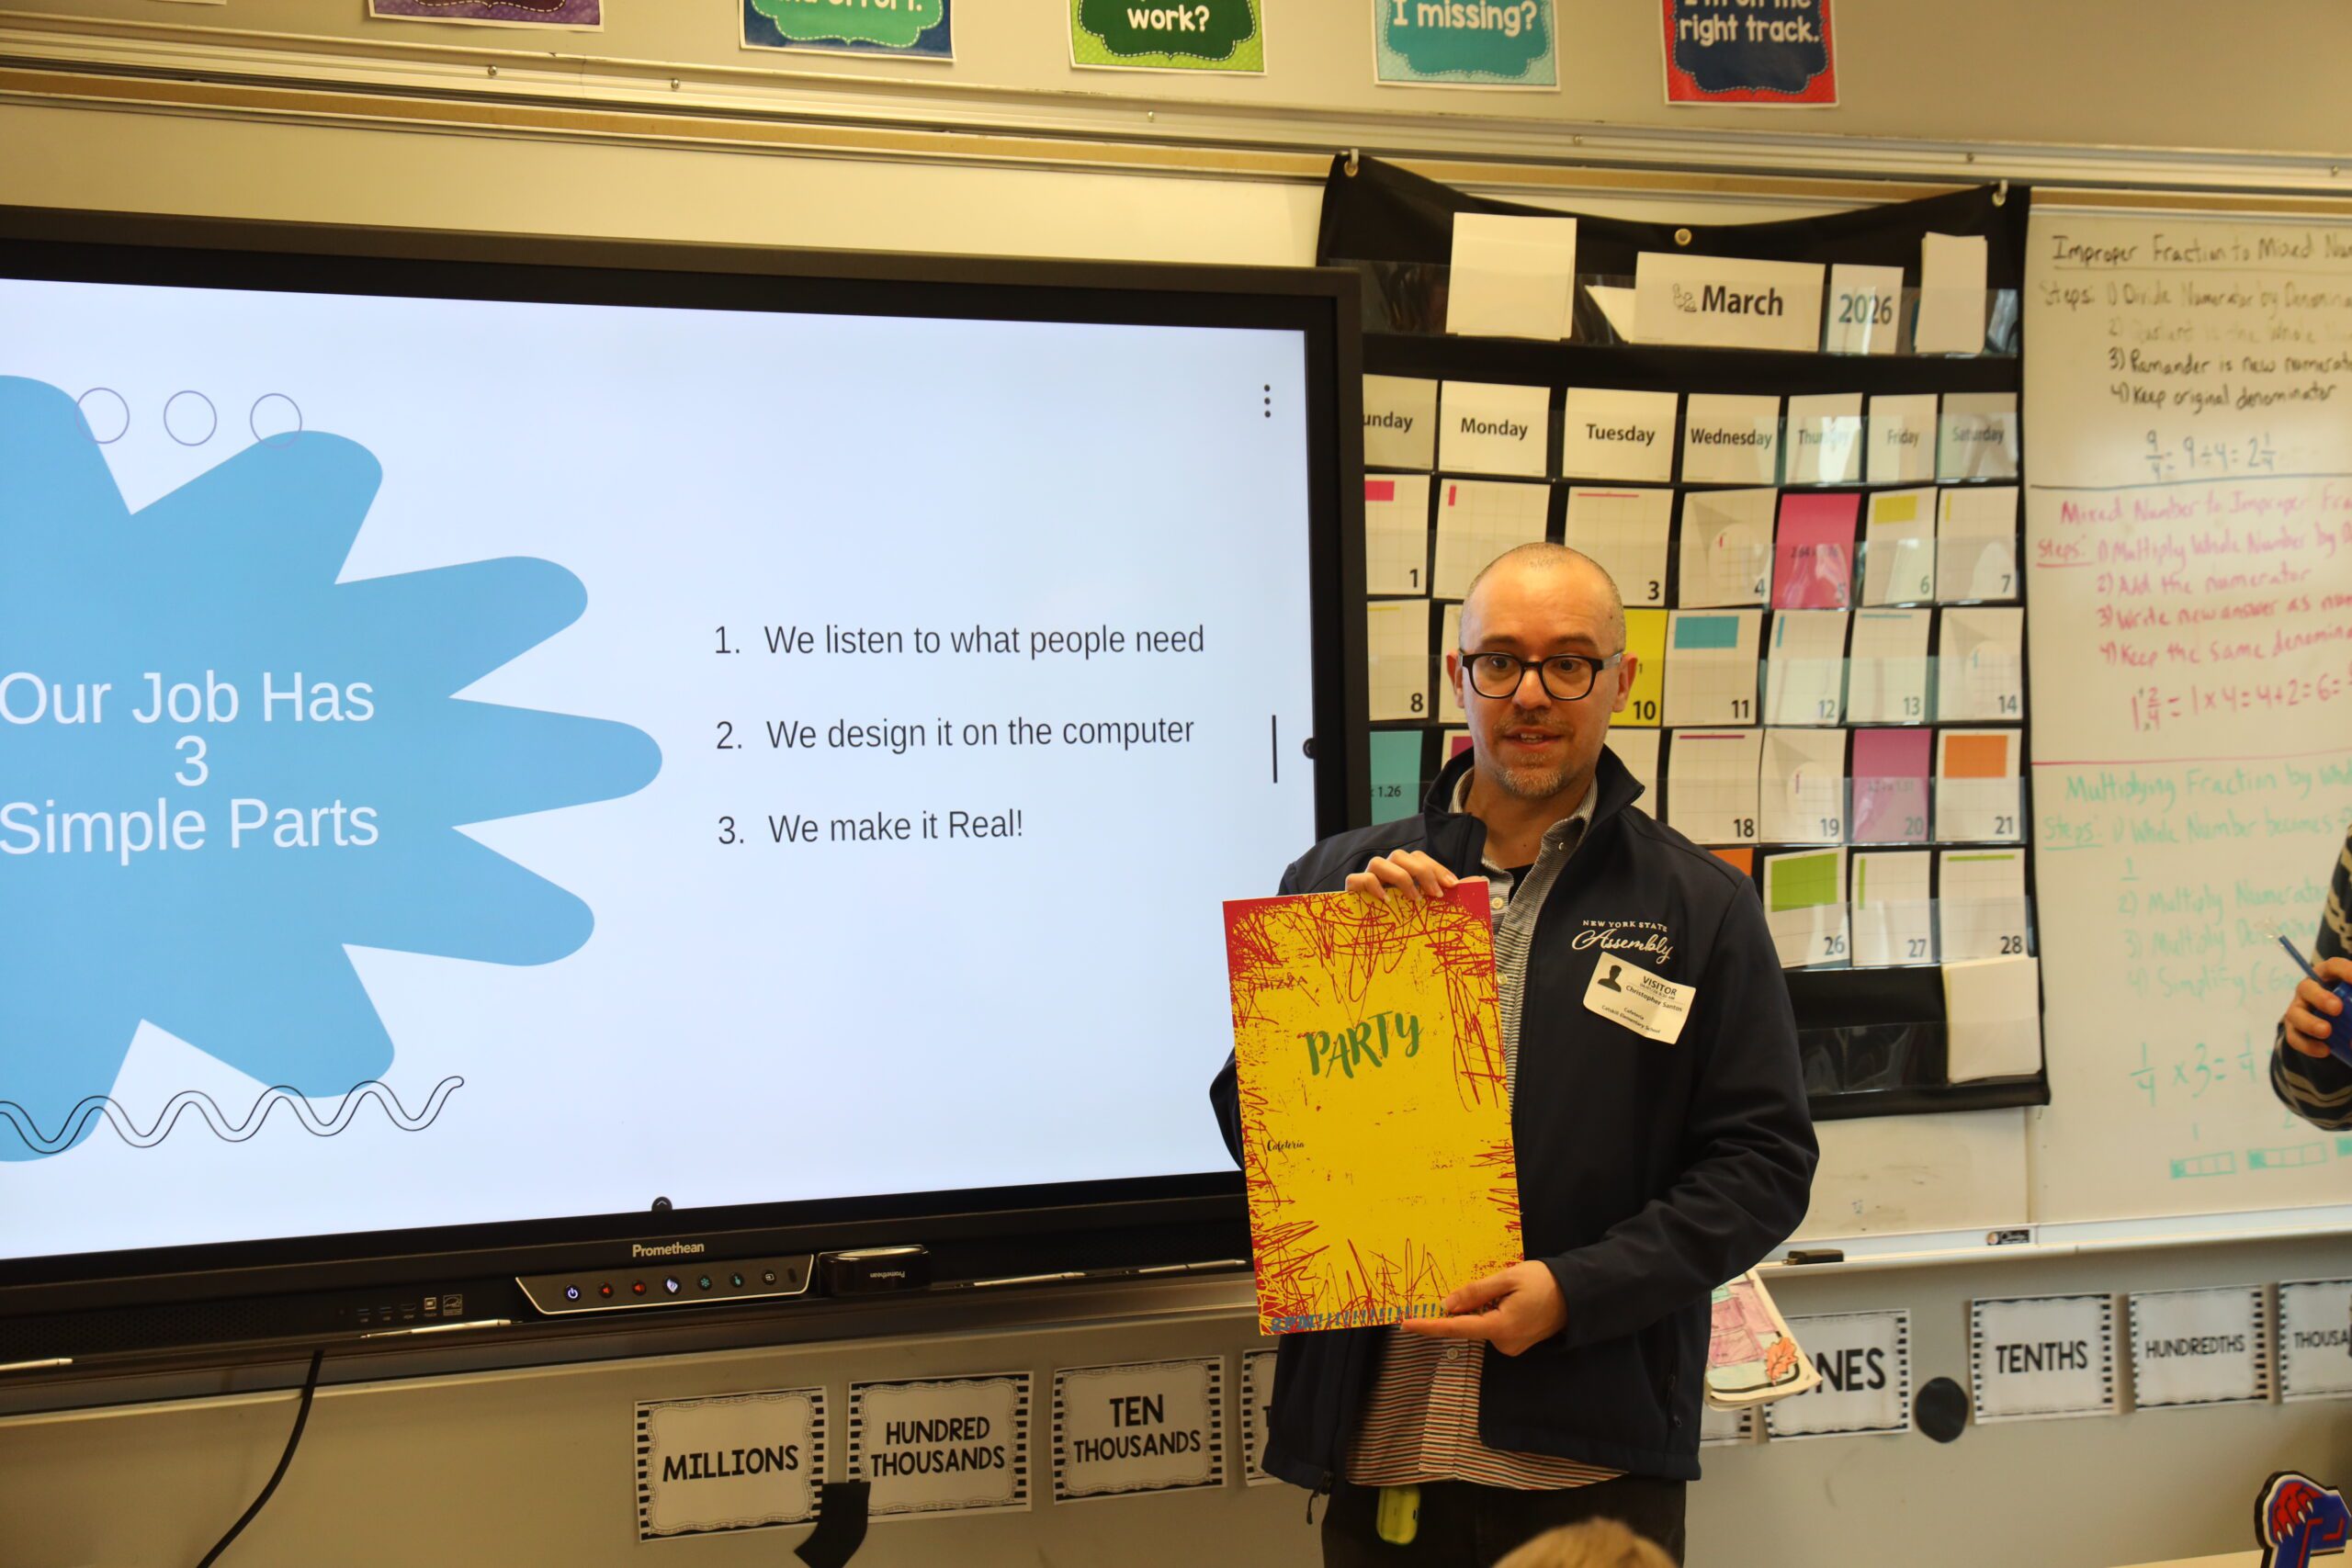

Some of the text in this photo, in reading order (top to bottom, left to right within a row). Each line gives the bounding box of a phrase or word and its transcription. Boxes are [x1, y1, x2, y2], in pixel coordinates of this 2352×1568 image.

[1126, 4, 1210, 32] work?
[1393, 0, 1537, 38] I missing?
[1679, 14, 1819, 47] right track.
[2051, 234, 2138, 266] Improper
[2153, 232, 2225, 264] Fraction
[2231, 235, 2250, 262] to
[1702, 284, 1783, 317] March
[1838, 293, 1893, 324] 2026
[2242, 355, 2277, 374] new
[2132, 386, 2166, 411] Keep
[2173, 382, 2231, 416] original
[2234, 379, 2337, 412] denominator
[1363, 412, 1413, 434] unday
[1460, 417, 1529, 450] Monday
[1951, 426, 2005, 445] Saturday
[1586, 423, 1656, 457] Tuesday
[1690, 427, 1772, 449] Wednesday
[1798, 428, 1849, 448] Thuray
[1887, 428, 1920, 449] Friday
[2060, 494, 2122, 525] Mixed
[2133, 495, 2200, 522] Number
[2206, 488, 2221, 514] to
[2229, 490, 2309, 518] Improper
[2113, 533, 2186, 574] Multiply
[2313, 520, 2336, 559] by
[1408, 569, 1419, 589] 1
[1753, 578, 1766, 597] 4
[1920, 576, 1930, 594] 6
[2001, 574, 2012, 593] 7
[2118, 573, 2151, 596] Add
[2161, 574, 2193, 595] the
[2206, 558, 2312, 592] numerator
[1646, 581, 1660, 601] 3
[2116, 606, 2170, 630] Write
[2177, 607, 2217, 626] new
[2221, 599, 2280, 620] answer
[2286, 593, 2311, 614] as
[715, 624, 1204, 660] 1. We listen to what people need
[2120, 643, 2158, 669] Keep
[2166, 642, 2200, 664] the
[0, 670, 375, 725] Our Job Has
[1409, 693, 1424, 713] 8
[1633, 699, 1657, 721] 10
[1731, 699, 1750, 720] 11
[1818, 698, 1837, 720] 12
[1904, 696, 1921, 716] 13
[1997, 694, 2018, 715] 14
[716, 716, 1194, 754] 2. We design it on the computer
[175, 735, 209, 786] 3
[1377, 784, 1402, 798] 1.26
[2186, 766, 2278, 796] Fraction
[2284, 762, 2312, 801] by
[0, 796, 379, 866] Simple Parts
[718, 808, 1023, 844] 3. We make it Real!
[1733, 818, 1756, 839] 18
[1820, 818, 1839, 839] 19
[1904, 816, 1925, 837] 20
[1995, 816, 2015, 836] 21
[1582, 919, 1668, 933] NEW YORK STATE
[1571, 928, 1674, 964] Assembly
[1823, 935, 1846, 956] 26
[1907, 938, 1927, 958] 27
[1999, 935, 2023, 955] 28
[1625, 985, 1662, 1006] Christopher
[1662, 1001, 1683, 1012] Santos
[1643, 976, 1678, 997] VISITOR
[1305, 1010, 1424, 1079] PARTY
[1266, 1139, 1306, 1152] Cafeteria
[631, 1241, 706, 1258] Promethean
[2145, 1334, 2245, 1359] HUNDREDTHS
[2293, 1328, 2349, 1348] THOUSA
[1995, 1340, 2089, 1374] TENTHS
[1798, 1347, 1886, 1395] NES
[1109, 1393, 1165, 1427] TEN
[885, 1416, 991, 1446] HUNDRED
[1073, 1428, 1202, 1464] THOUSANDS
[662, 1444, 800, 1483] MILLIONS
[870, 1445, 1006, 1478] THOUSANDS
